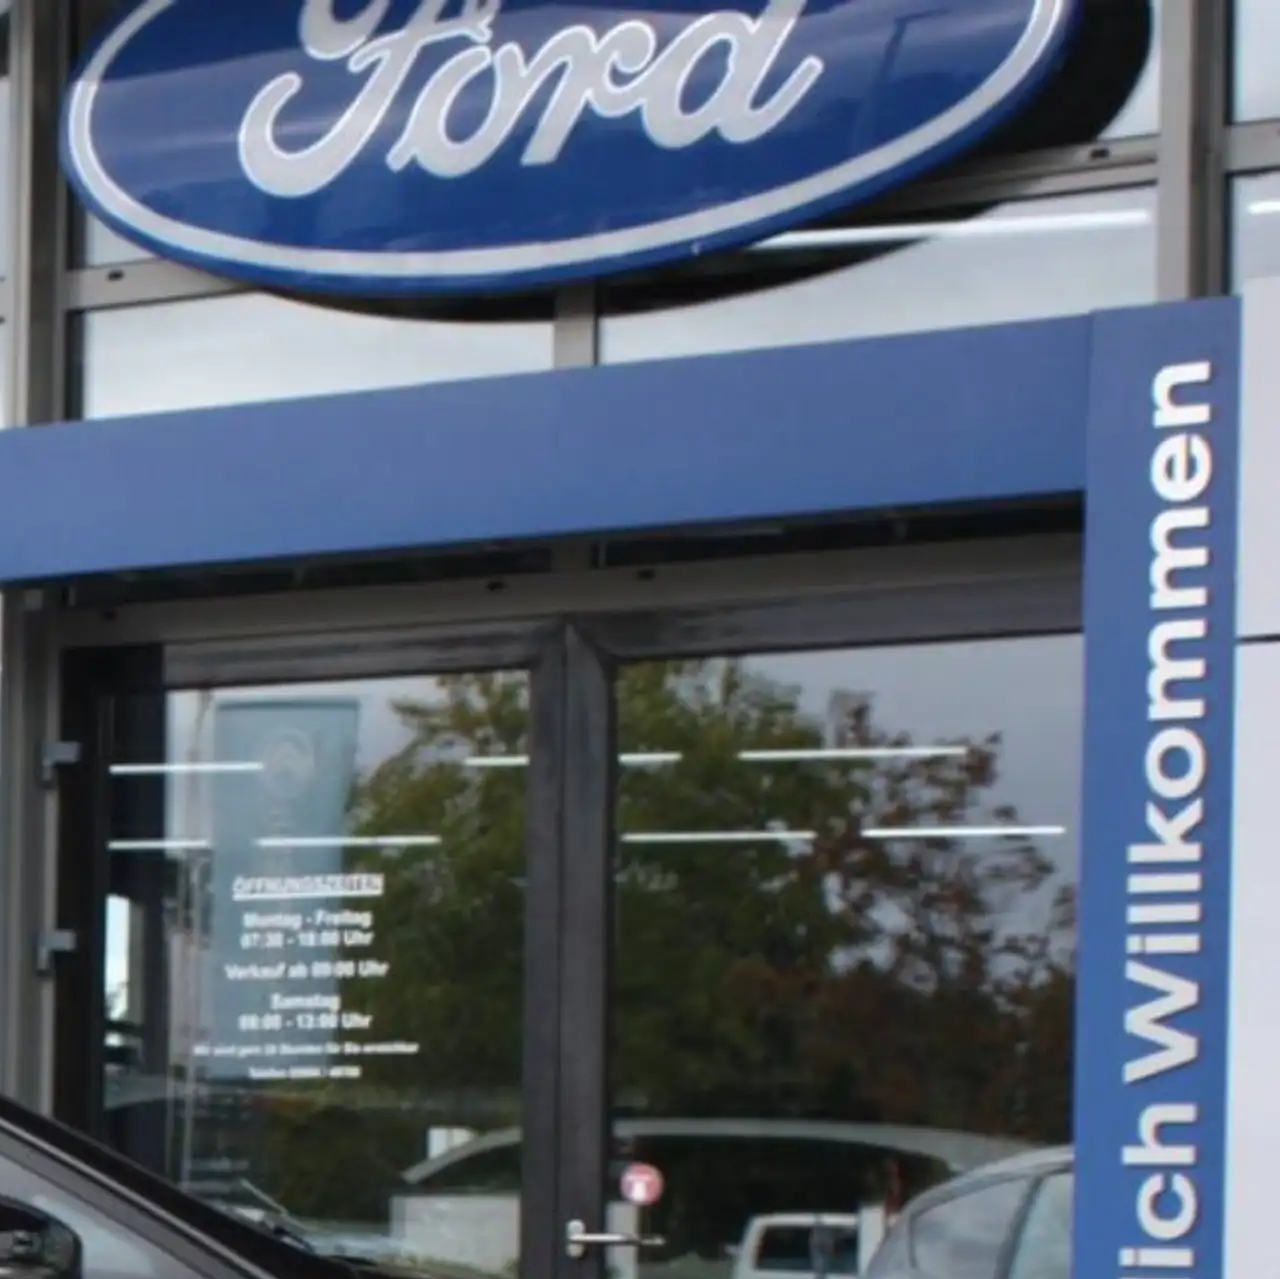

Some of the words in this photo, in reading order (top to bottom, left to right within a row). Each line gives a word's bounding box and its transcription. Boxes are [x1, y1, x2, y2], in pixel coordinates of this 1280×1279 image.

[238, 0, 825, 197] Ford
[1120, 360, 1213, 1084] Willkommen
[343, 929, 374, 946] Uhr
[358, 959, 389, 977] Uhr
[341, 1012, 373, 1029] Uhr
